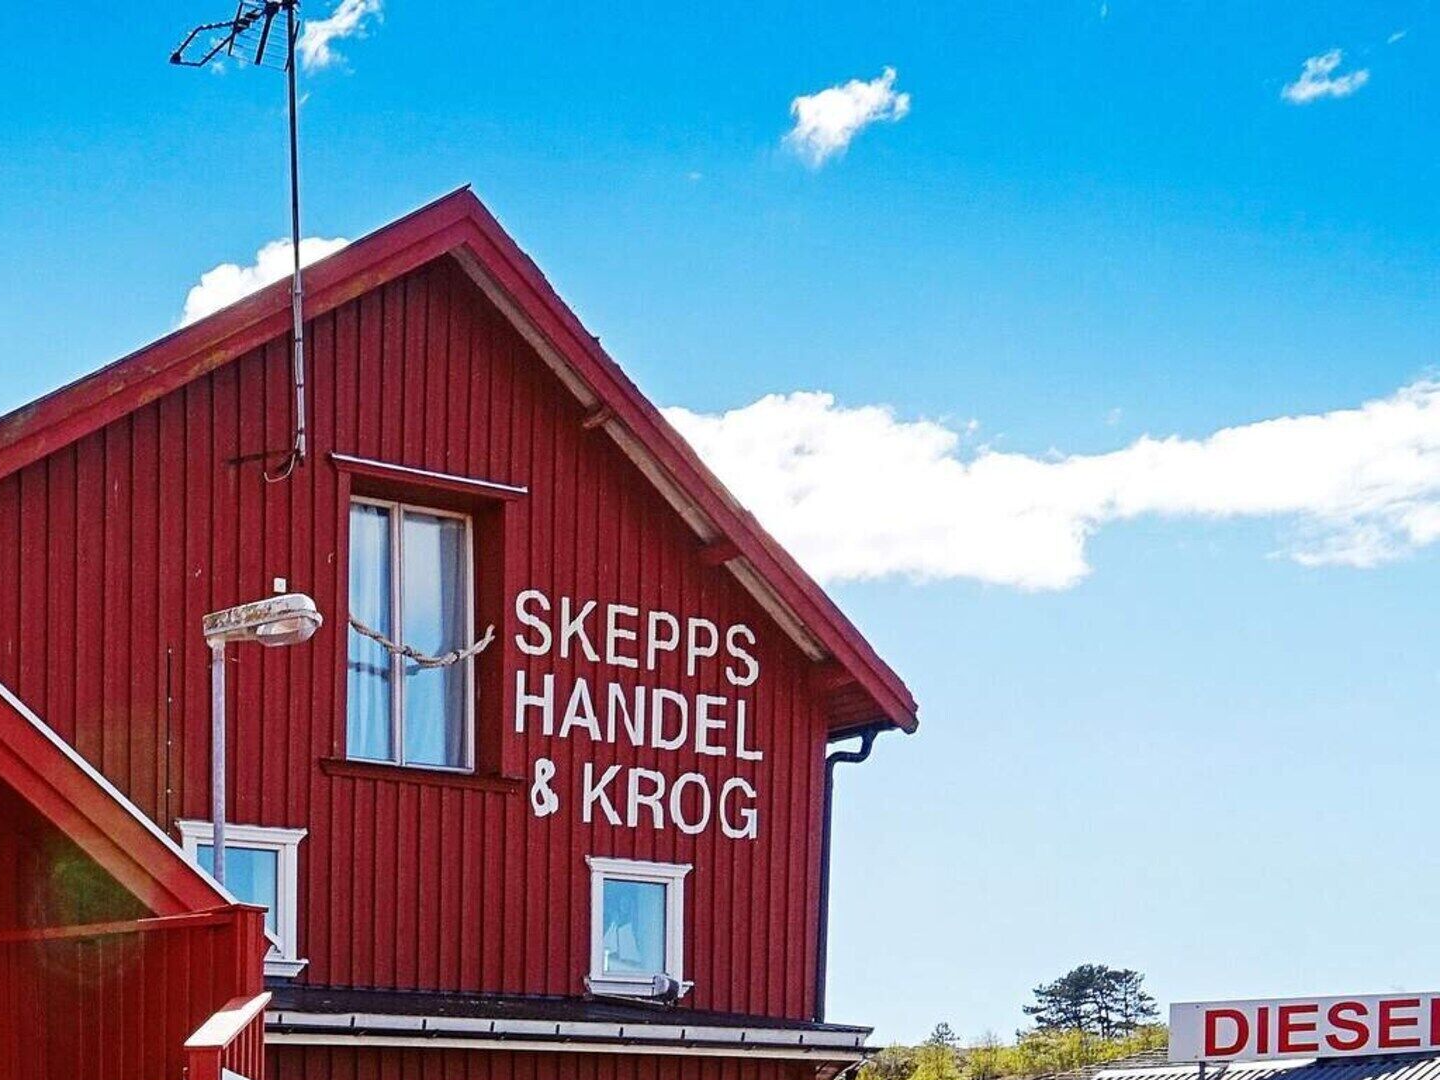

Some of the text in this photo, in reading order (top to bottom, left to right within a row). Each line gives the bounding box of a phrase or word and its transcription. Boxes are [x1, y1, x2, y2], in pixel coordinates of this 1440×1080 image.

[514, 589, 760, 687] SKEPPS
[514, 670, 763, 761] HANDEL
[530, 757, 758, 840] & KROG
[1205, 997, 1440, 1057] DIESE
